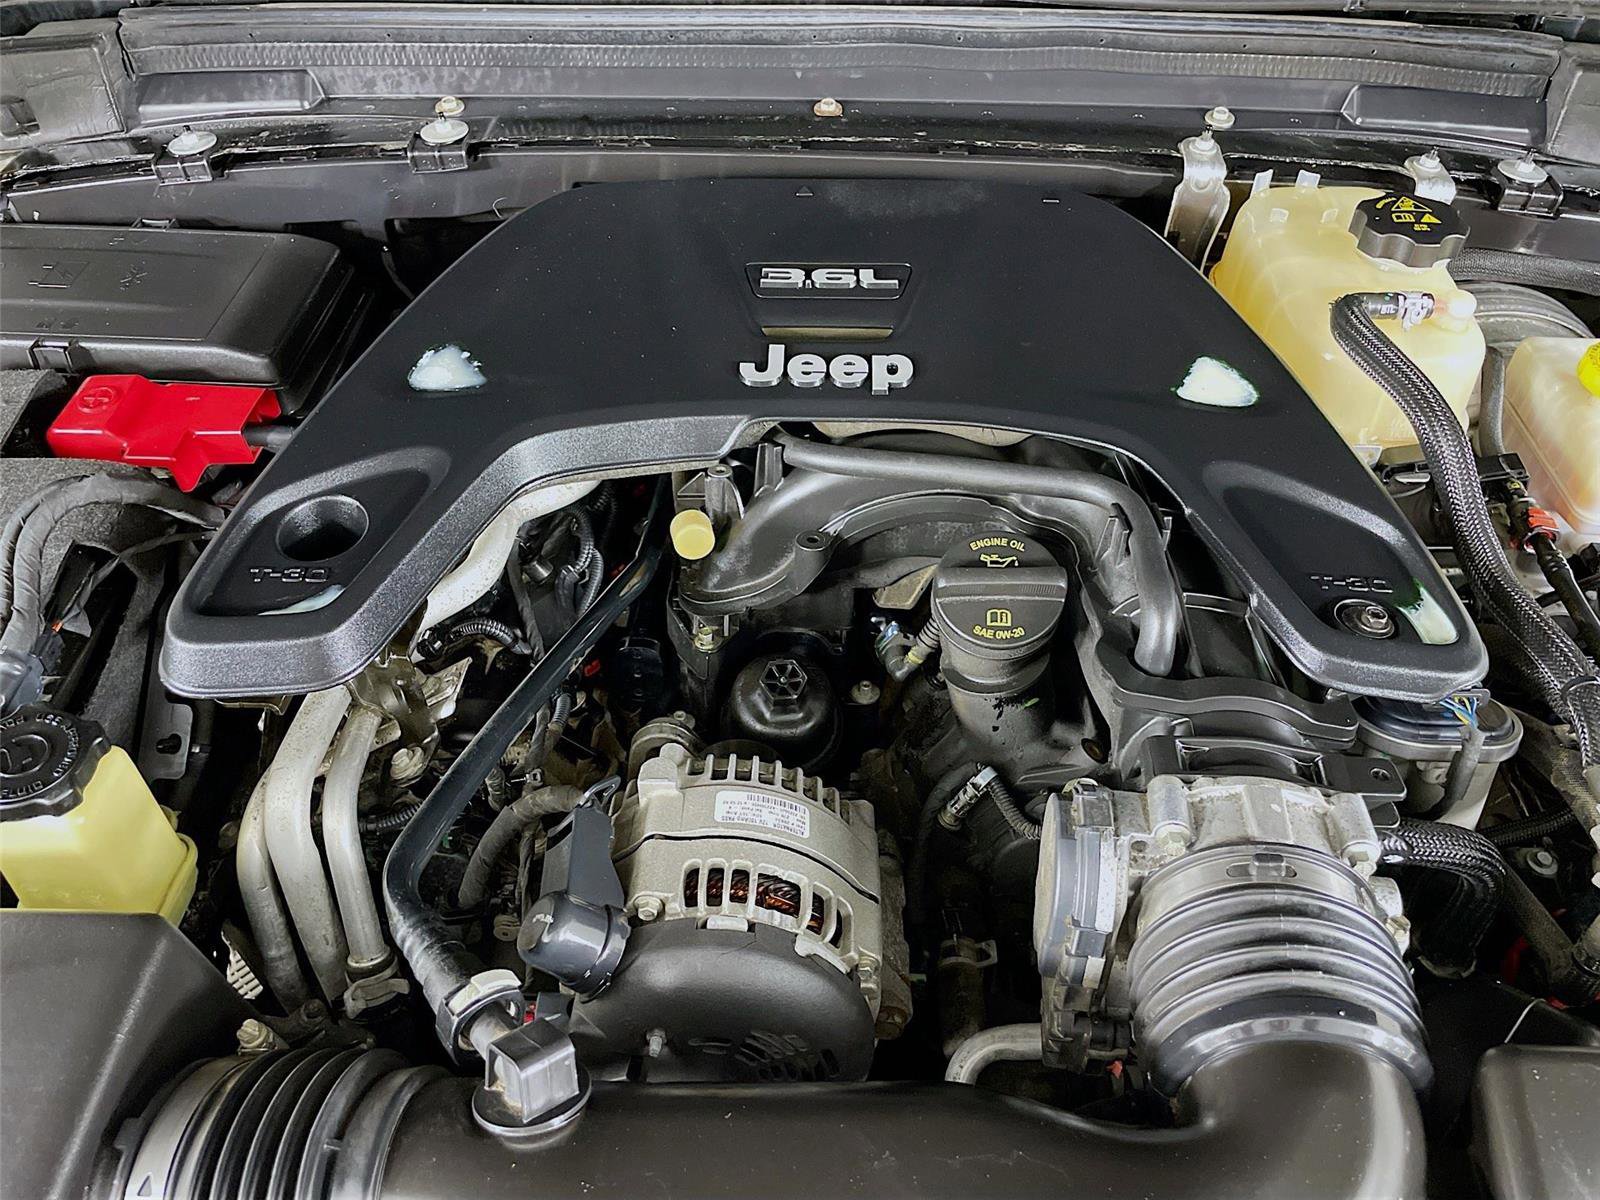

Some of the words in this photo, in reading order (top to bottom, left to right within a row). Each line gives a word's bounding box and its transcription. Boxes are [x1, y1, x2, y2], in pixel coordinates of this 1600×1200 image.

[760, 268, 899, 289] 3.6L
[739, 344, 914, 395] Jeep
[969, 537, 1008, 551] ENGINE
[1009, 539, 1025, 552] OIL
[250, 567, 328, 582] T-30
[972, 625, 995, 639] SAE
[995, 627, 1025, 639] 0W-20
